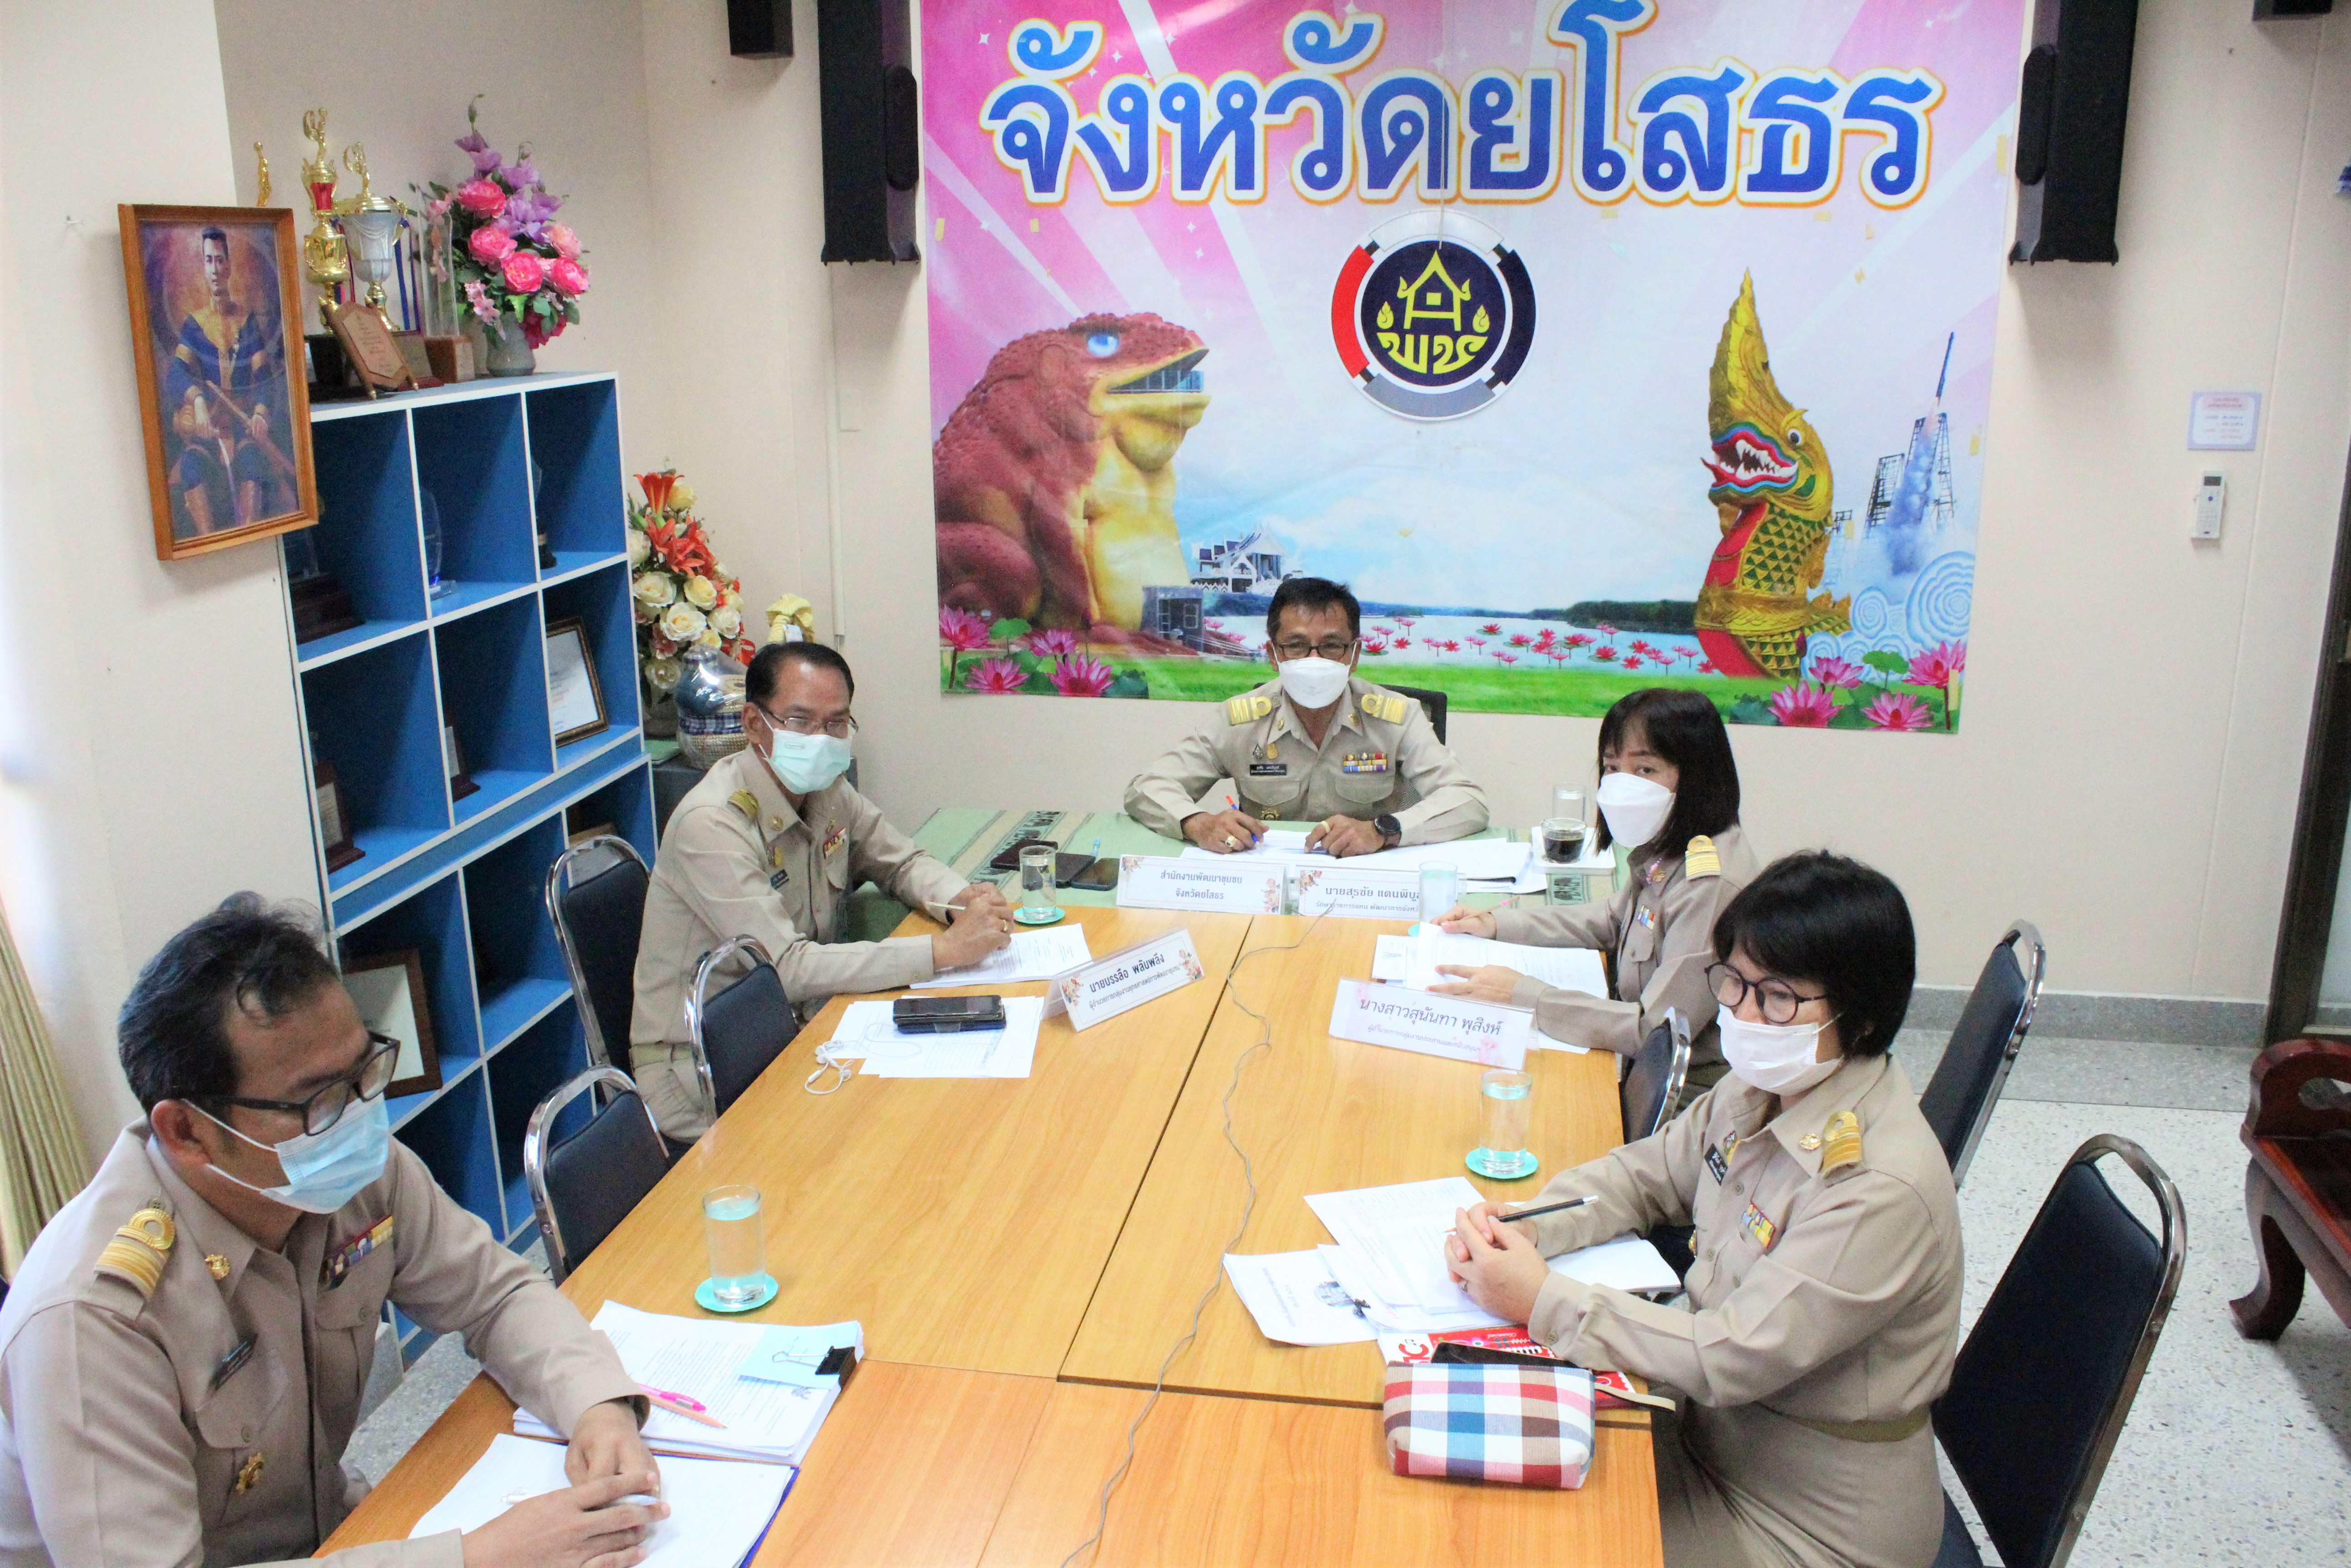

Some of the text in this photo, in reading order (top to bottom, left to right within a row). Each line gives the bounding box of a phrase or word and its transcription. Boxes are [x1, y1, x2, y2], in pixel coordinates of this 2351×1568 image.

[984, 0, 1936, 198] จังหวัดยโสธร
[1160, 870, 1242, 885] สำนักงานพัฒนาชุมชน
[1176, 888, 1224, 900] จังหวัดยโสธร
[1325, 886, 1373, 898] นายสุรชัย
[1089, 969, 1129, 993] นายบรรลือ
[1360, 998, 1504, 1035] นางสาวสุนันทา พุสิงห์
